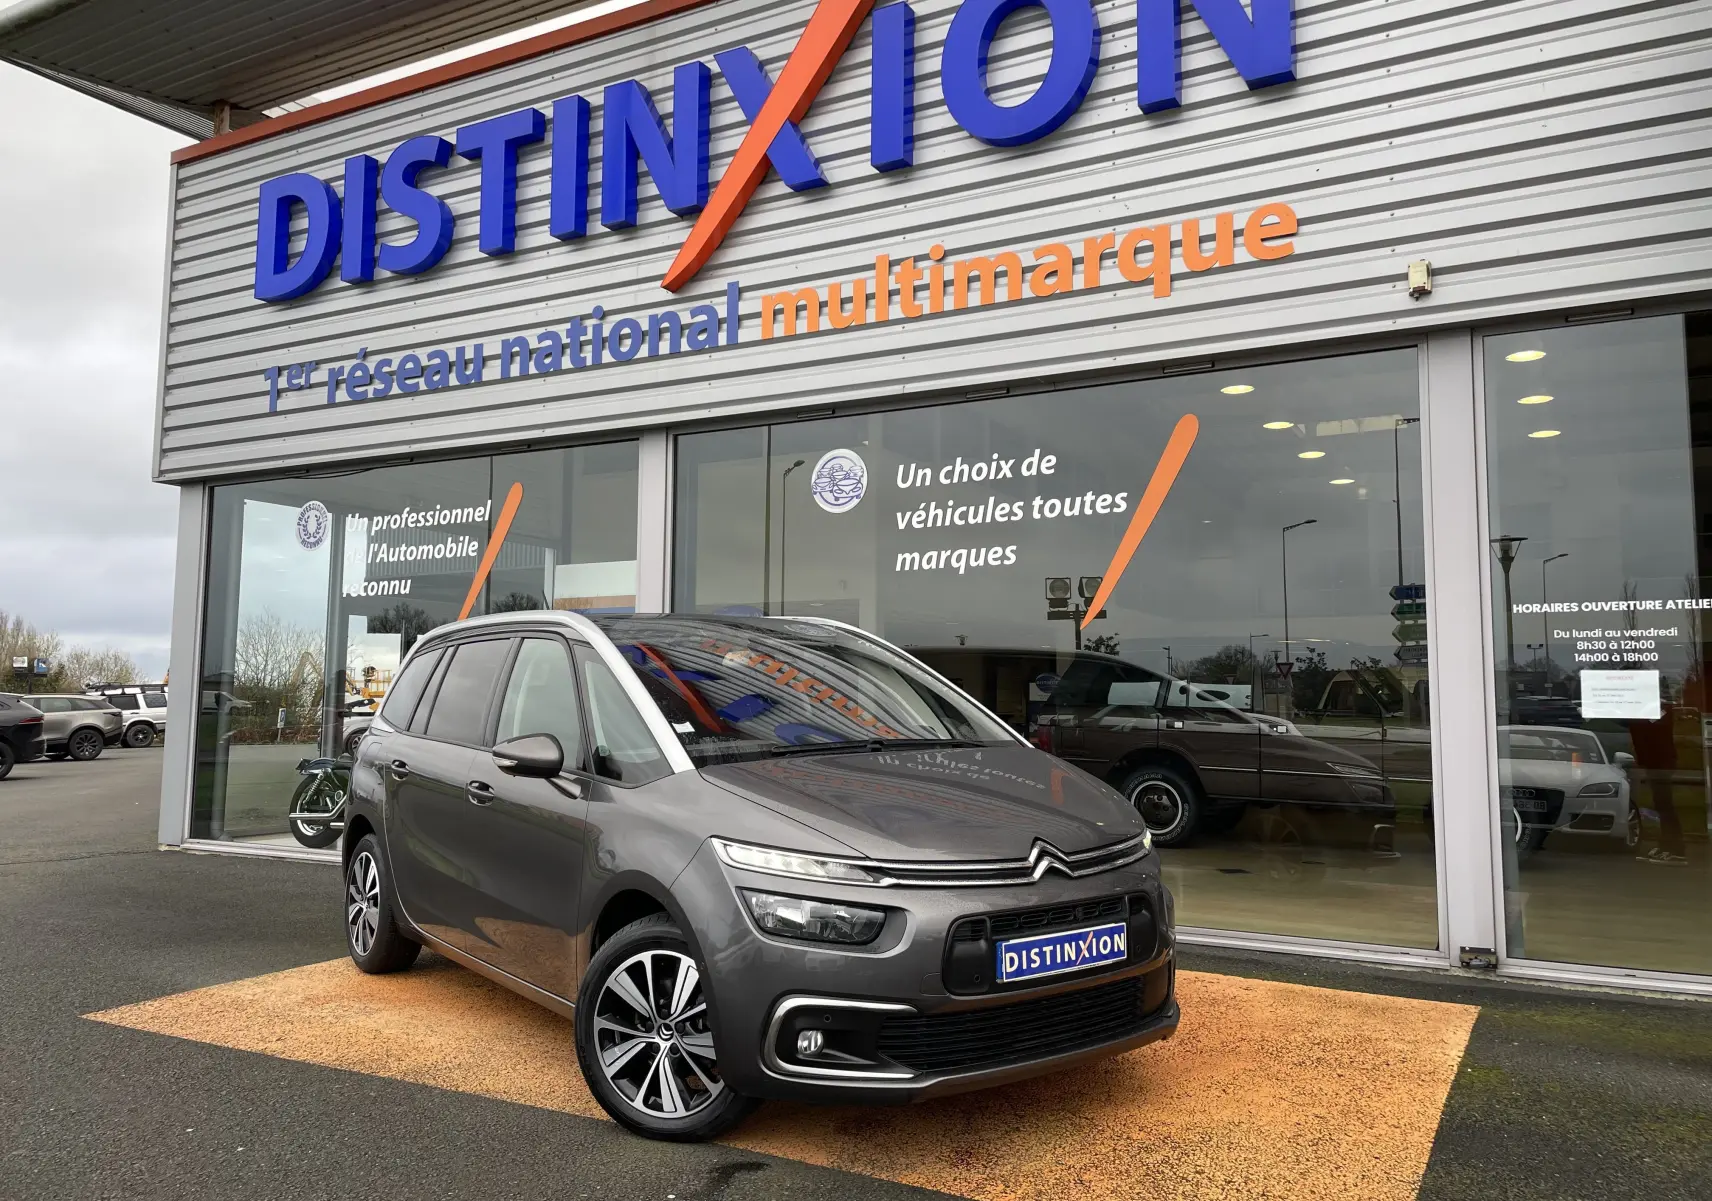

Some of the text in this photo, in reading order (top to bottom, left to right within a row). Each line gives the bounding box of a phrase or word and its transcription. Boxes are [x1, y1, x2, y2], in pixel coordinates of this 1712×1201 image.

[254, 0, 1297, 305] DISTINXION
[264, 202, 1299, 412] 1er réseau national multimarque
[896, 448, 1057, 488] Un choix de
[346, 499, 492, 536] Un professionnel
[895, 490, 1128, 530] véhicules toutes
[367, 535, 479, 564] l'Automobile
[895, 543, 1017, 574] marques
[342, 578, 412, 598] reconnu
[1513, 598, 1712, 613] HORAIRES OUVERTURE ATELIE
[1554, 629, 1569, 638] Du
[1573, 628, 1602, 638] lundi
[1623, 627, 1678, 637] vendredi
[1576, 640, 1655, 650] 8h30 à 12h00
[1574, 652, 1659, 662] 14h00 à 18h00
[1005, 931, 1125, 973] DISTINXION
